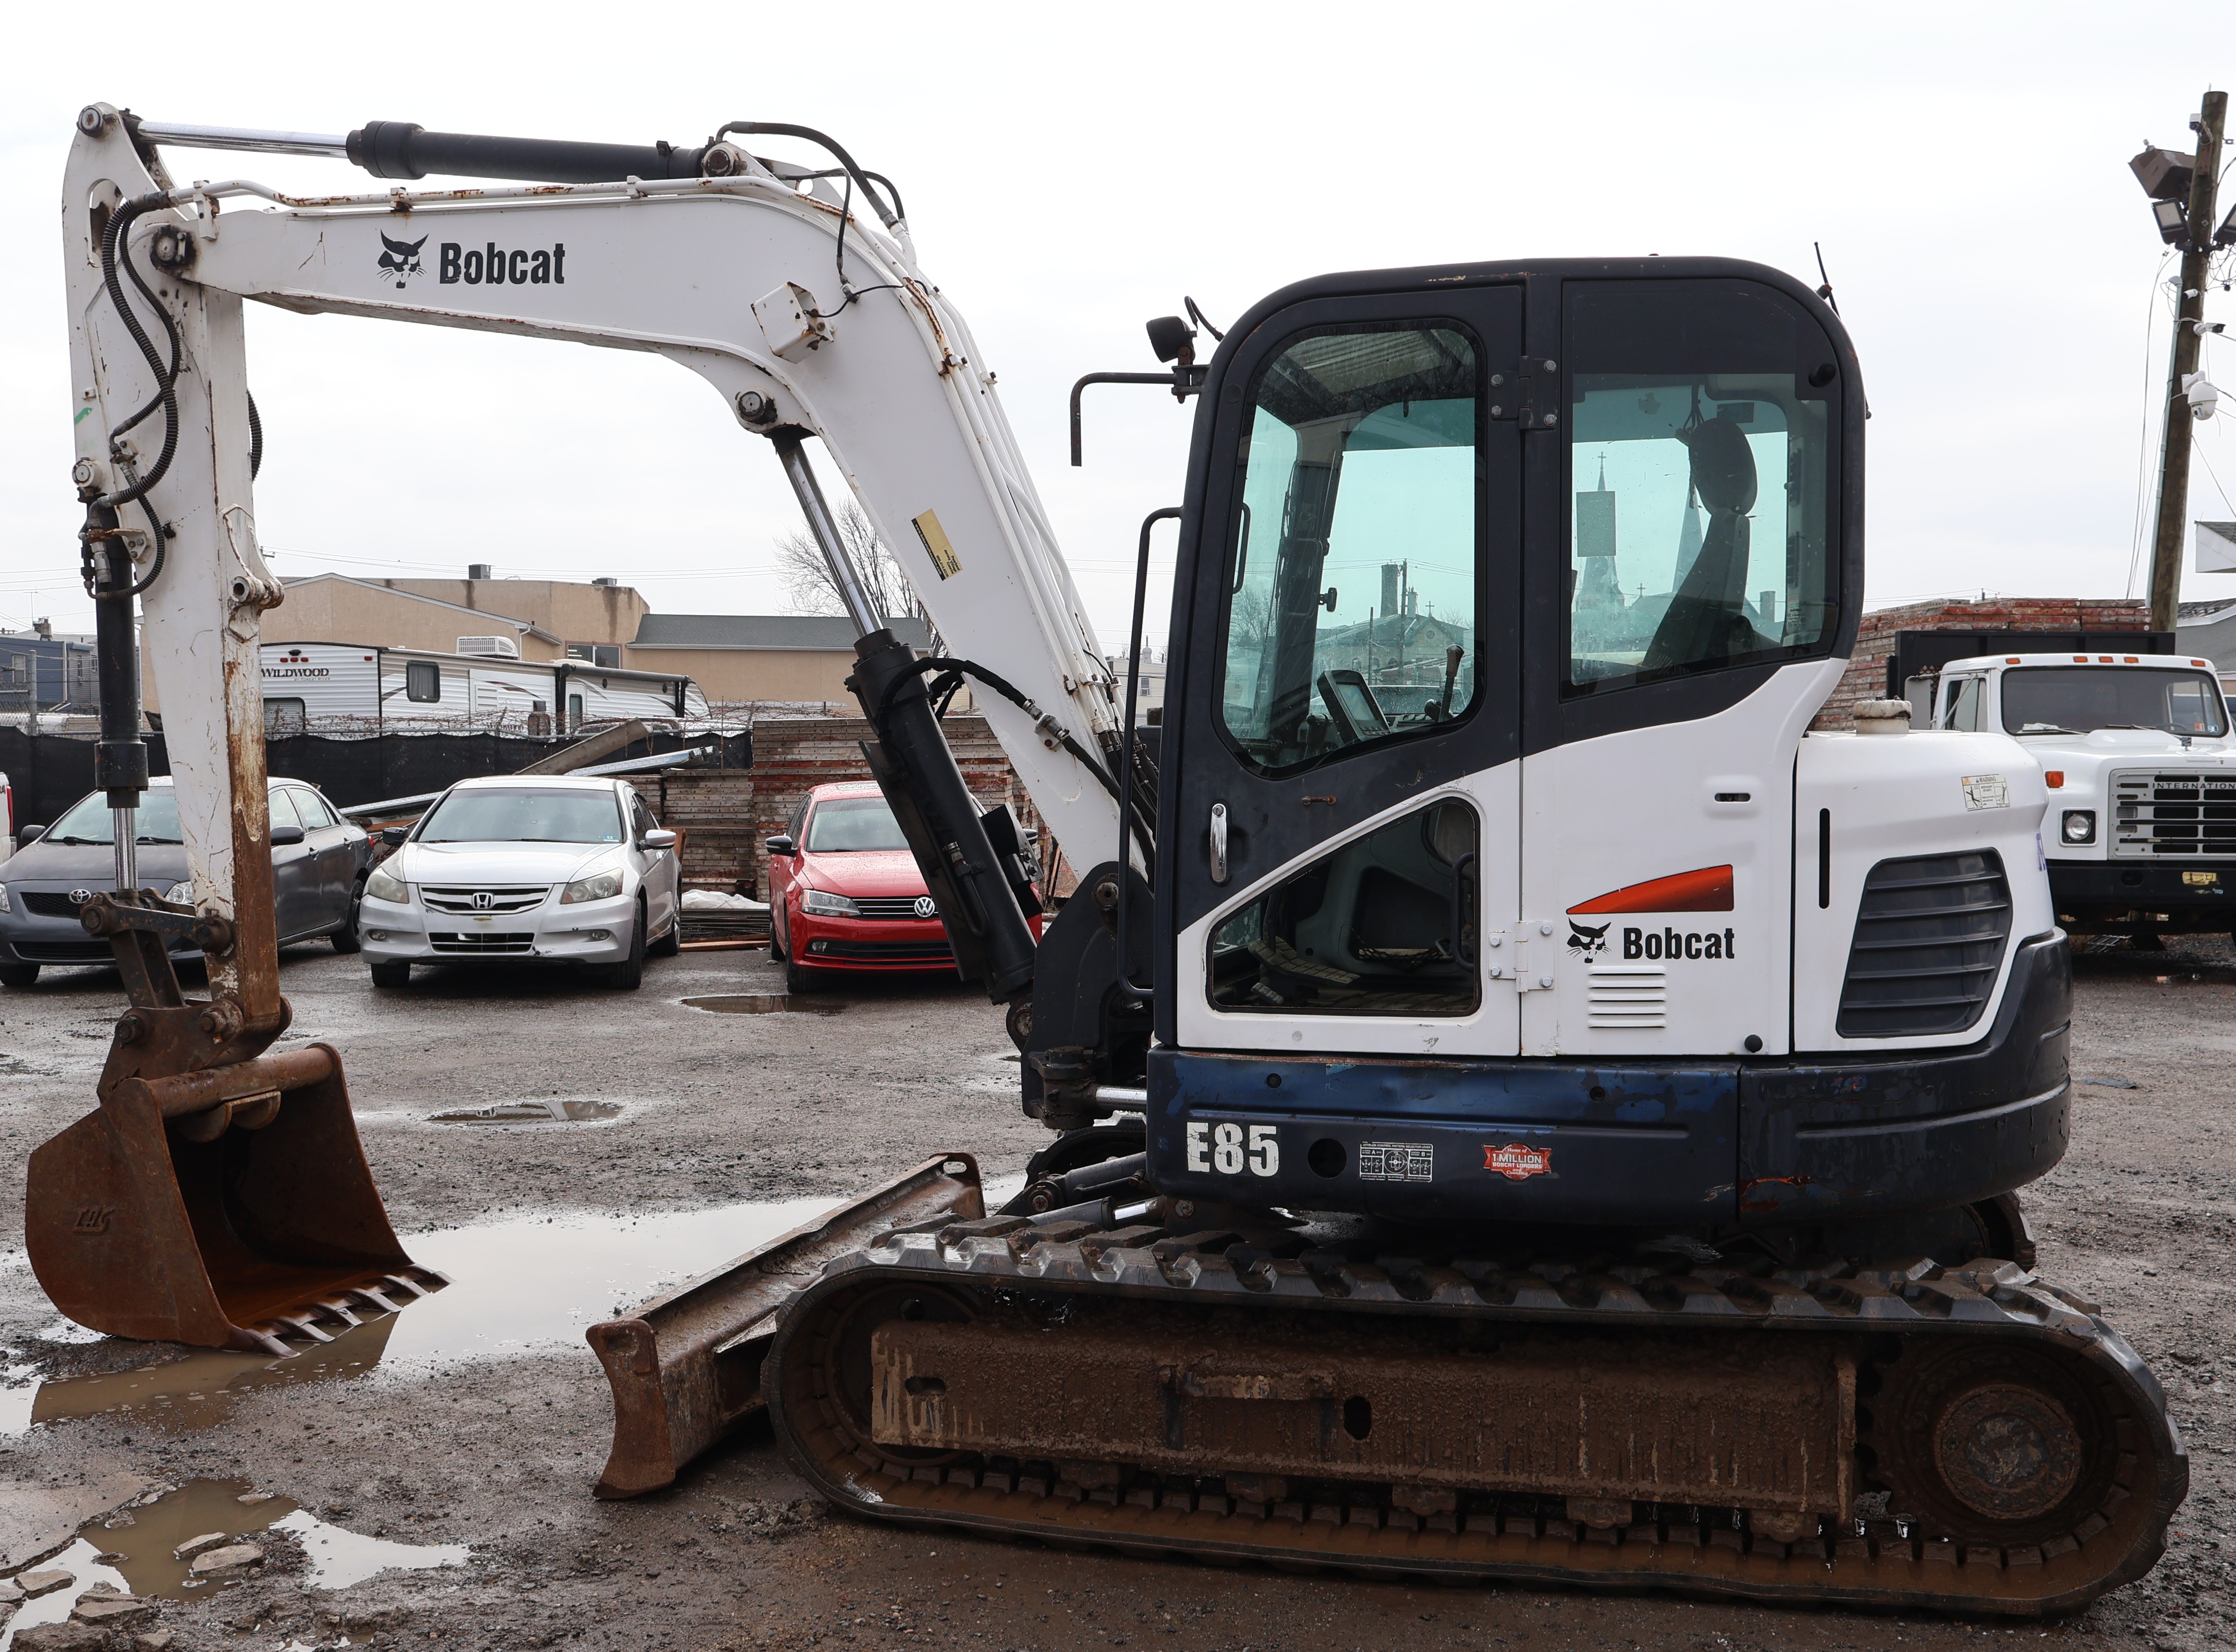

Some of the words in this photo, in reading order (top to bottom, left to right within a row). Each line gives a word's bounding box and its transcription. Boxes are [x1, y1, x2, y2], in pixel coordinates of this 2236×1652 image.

[440, 242, 565, 284] Bobcat
[261, 668, 329, 677] WILDWOOD
[1623, 927, 1735, 960] Bobcat
[1187, 1122, 1279, 1177] E85
[1492, 1153, 1496, 1162] 1
[1499, 1154, 1542, 1164] MILLION
